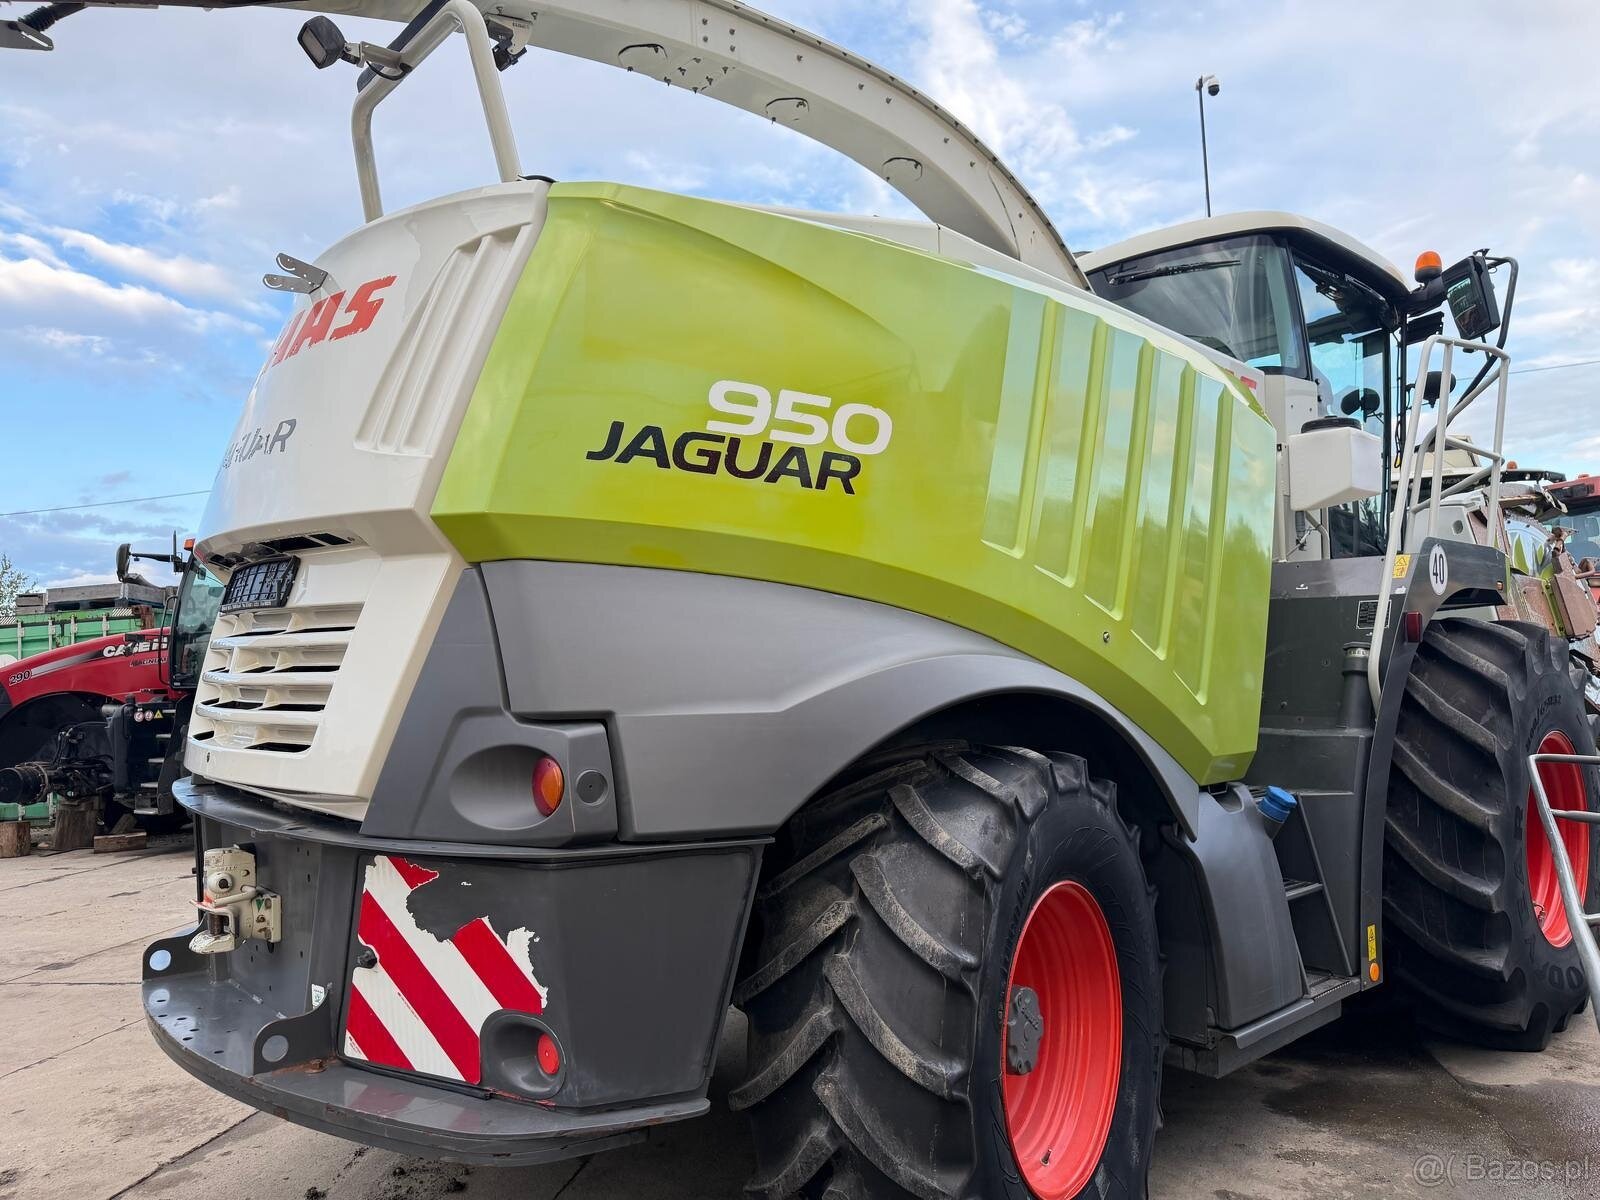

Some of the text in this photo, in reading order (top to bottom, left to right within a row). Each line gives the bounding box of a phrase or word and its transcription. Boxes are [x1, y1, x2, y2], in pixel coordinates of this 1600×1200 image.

[706, 380, 893, 455] 950
[586, 420, 861, 495] JAGUAR
[1432, 553, 1445, 585] 40
[9, 670, 32, 687] 290
